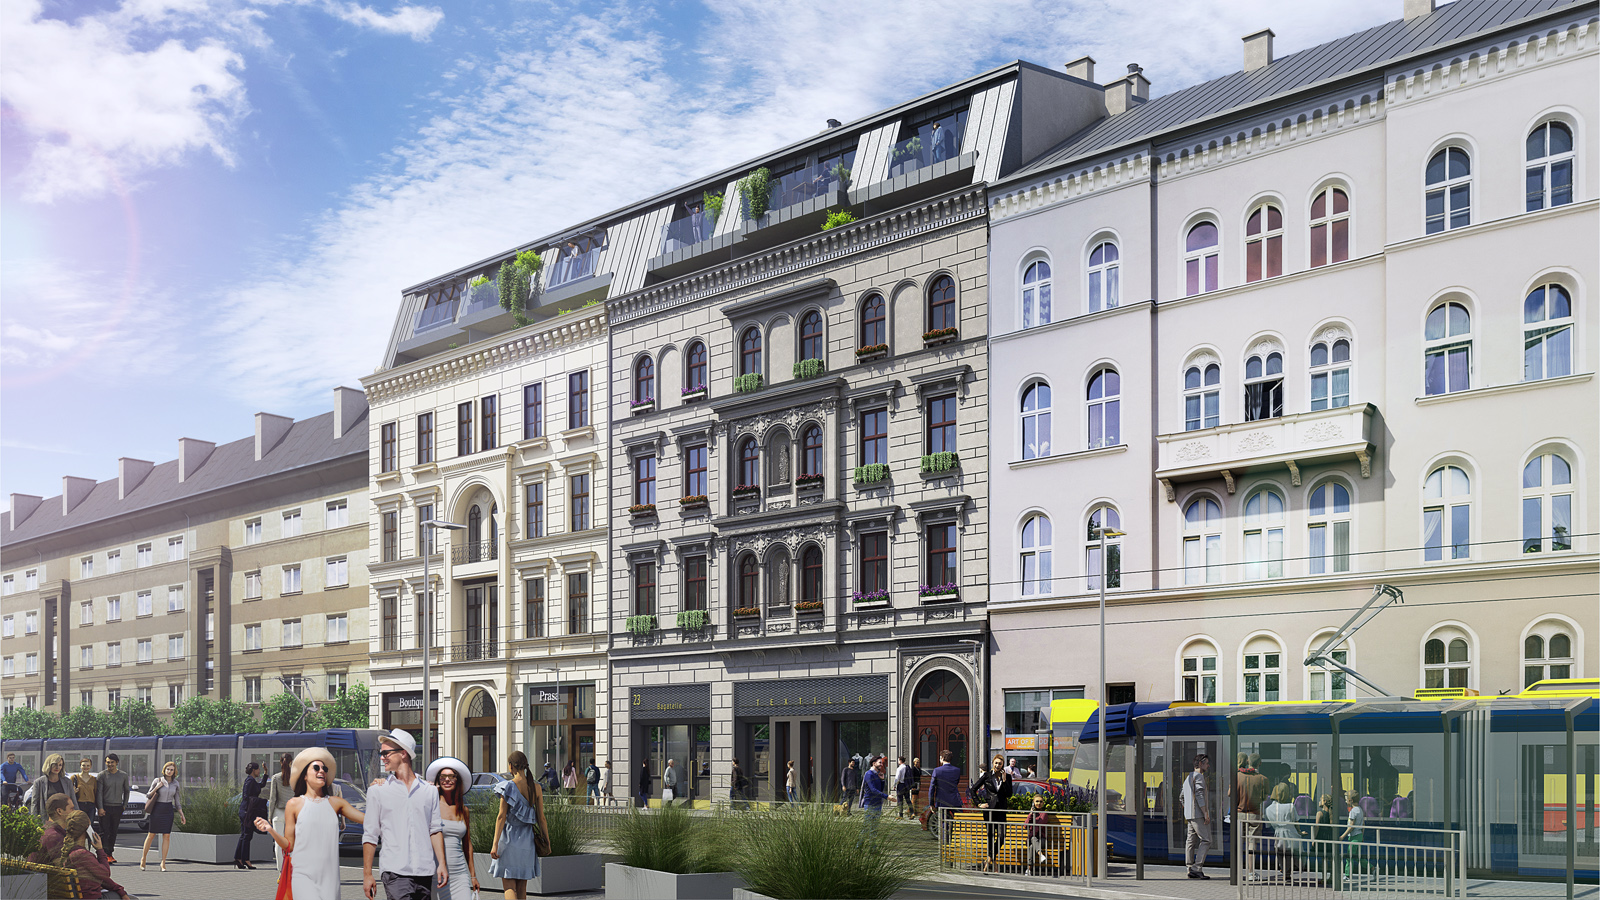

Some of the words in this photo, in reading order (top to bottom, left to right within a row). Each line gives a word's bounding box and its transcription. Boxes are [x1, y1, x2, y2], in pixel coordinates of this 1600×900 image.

[399, 697, 424, 709] Boutiqu
[633, 694, 641, 706] 23
[756, 695, 863, 706] TEXTILLO
[513, 709, 522, 719] 24
